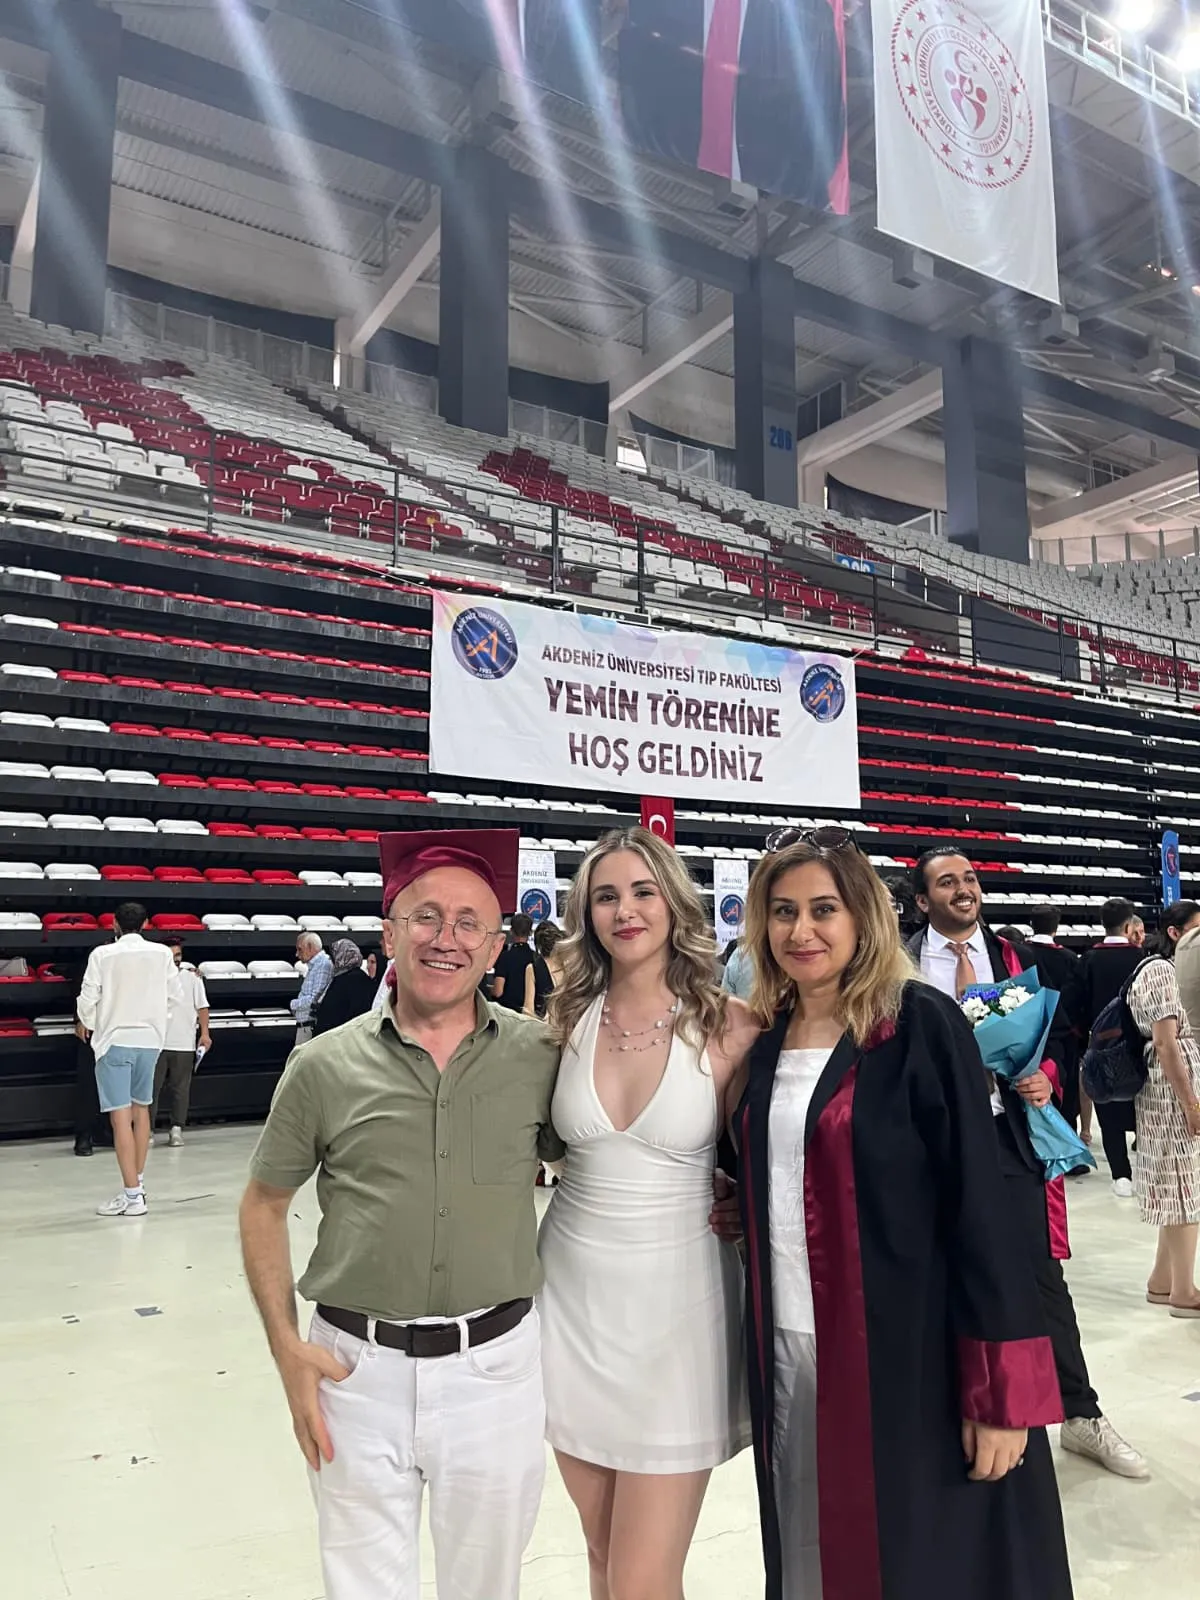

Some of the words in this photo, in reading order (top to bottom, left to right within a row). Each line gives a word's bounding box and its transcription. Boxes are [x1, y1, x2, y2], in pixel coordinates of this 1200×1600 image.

[541, 644, 605, 669] AKDENİZ
[607, 652, 694, 683] ÜNİVERSİTESİ
[697, 669, 717, 686] TIP
[719, 671, 782, 694] FAKÜLTESİ
[544, 677, 639, 723] YEMİN
[647, 689, 782, 738] TÖRENİNE
[568, 732, 629, 777] HOŞ
[638, 741, 763, 782] GELDİNİZ
